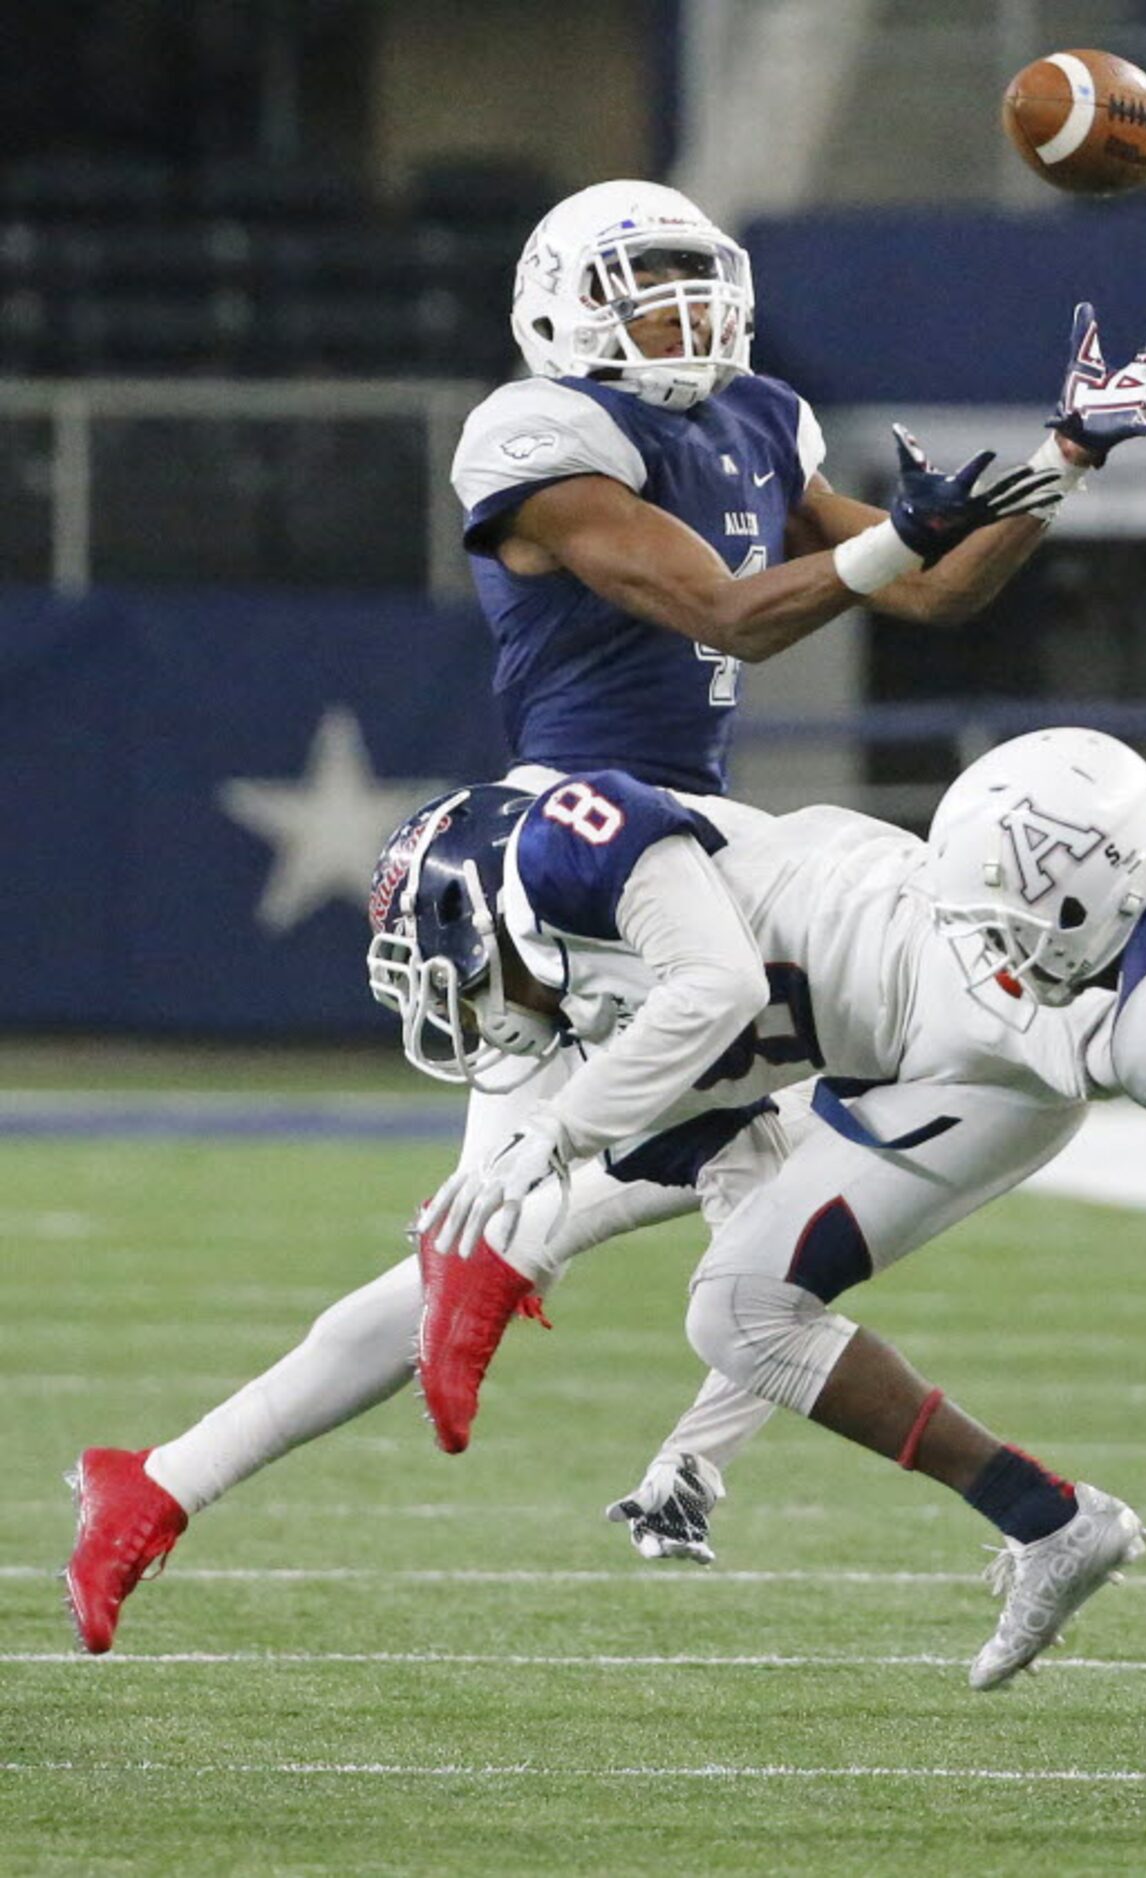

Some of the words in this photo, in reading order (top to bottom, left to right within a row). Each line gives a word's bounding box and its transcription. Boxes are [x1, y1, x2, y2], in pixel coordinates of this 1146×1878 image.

[724, 511, 760, 536] ALLEN
[543, 780, 626, 848] 8
[1000, 796, 1107, 905] A
